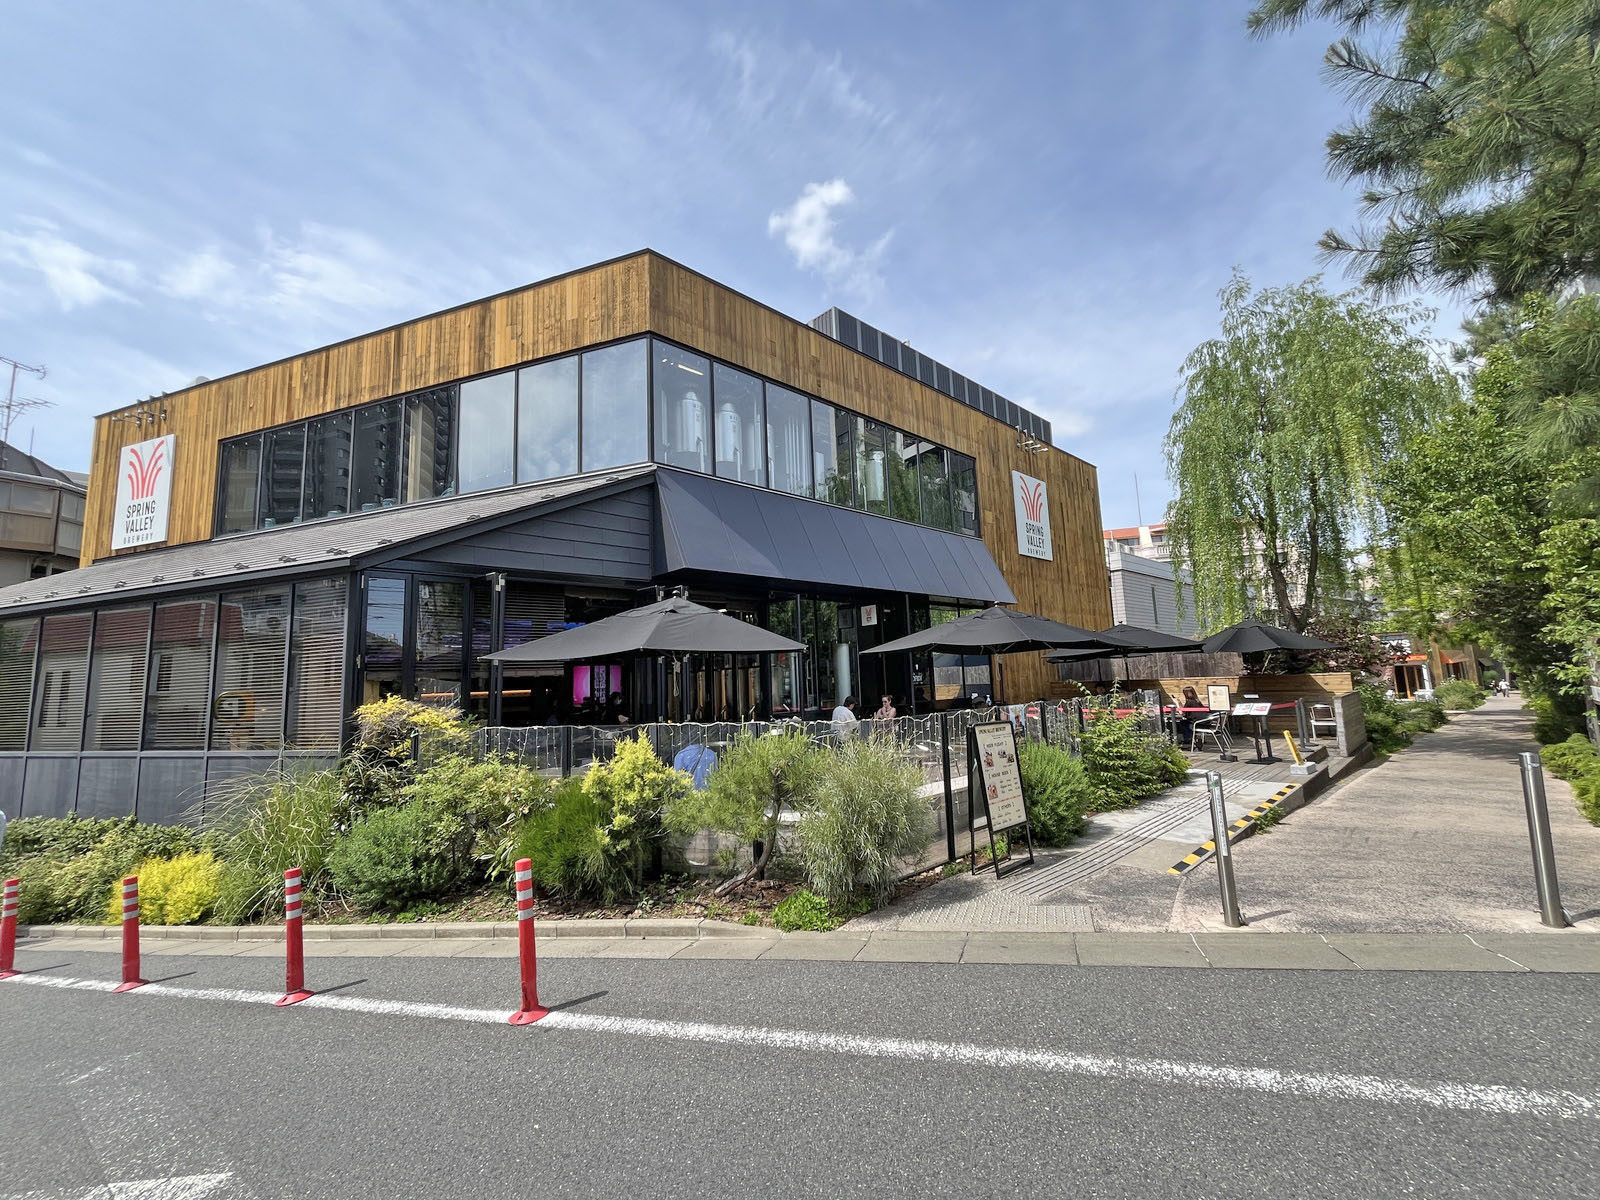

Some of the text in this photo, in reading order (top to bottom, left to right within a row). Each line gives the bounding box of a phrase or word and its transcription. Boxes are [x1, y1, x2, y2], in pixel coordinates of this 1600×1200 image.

[126, 500, 156, 519] SPRING
[125, 515, 155, 534] VALLEY
[1025, 522, 1044, 538] SPRING
[1026, 534, 1045, 549] VALLEY
